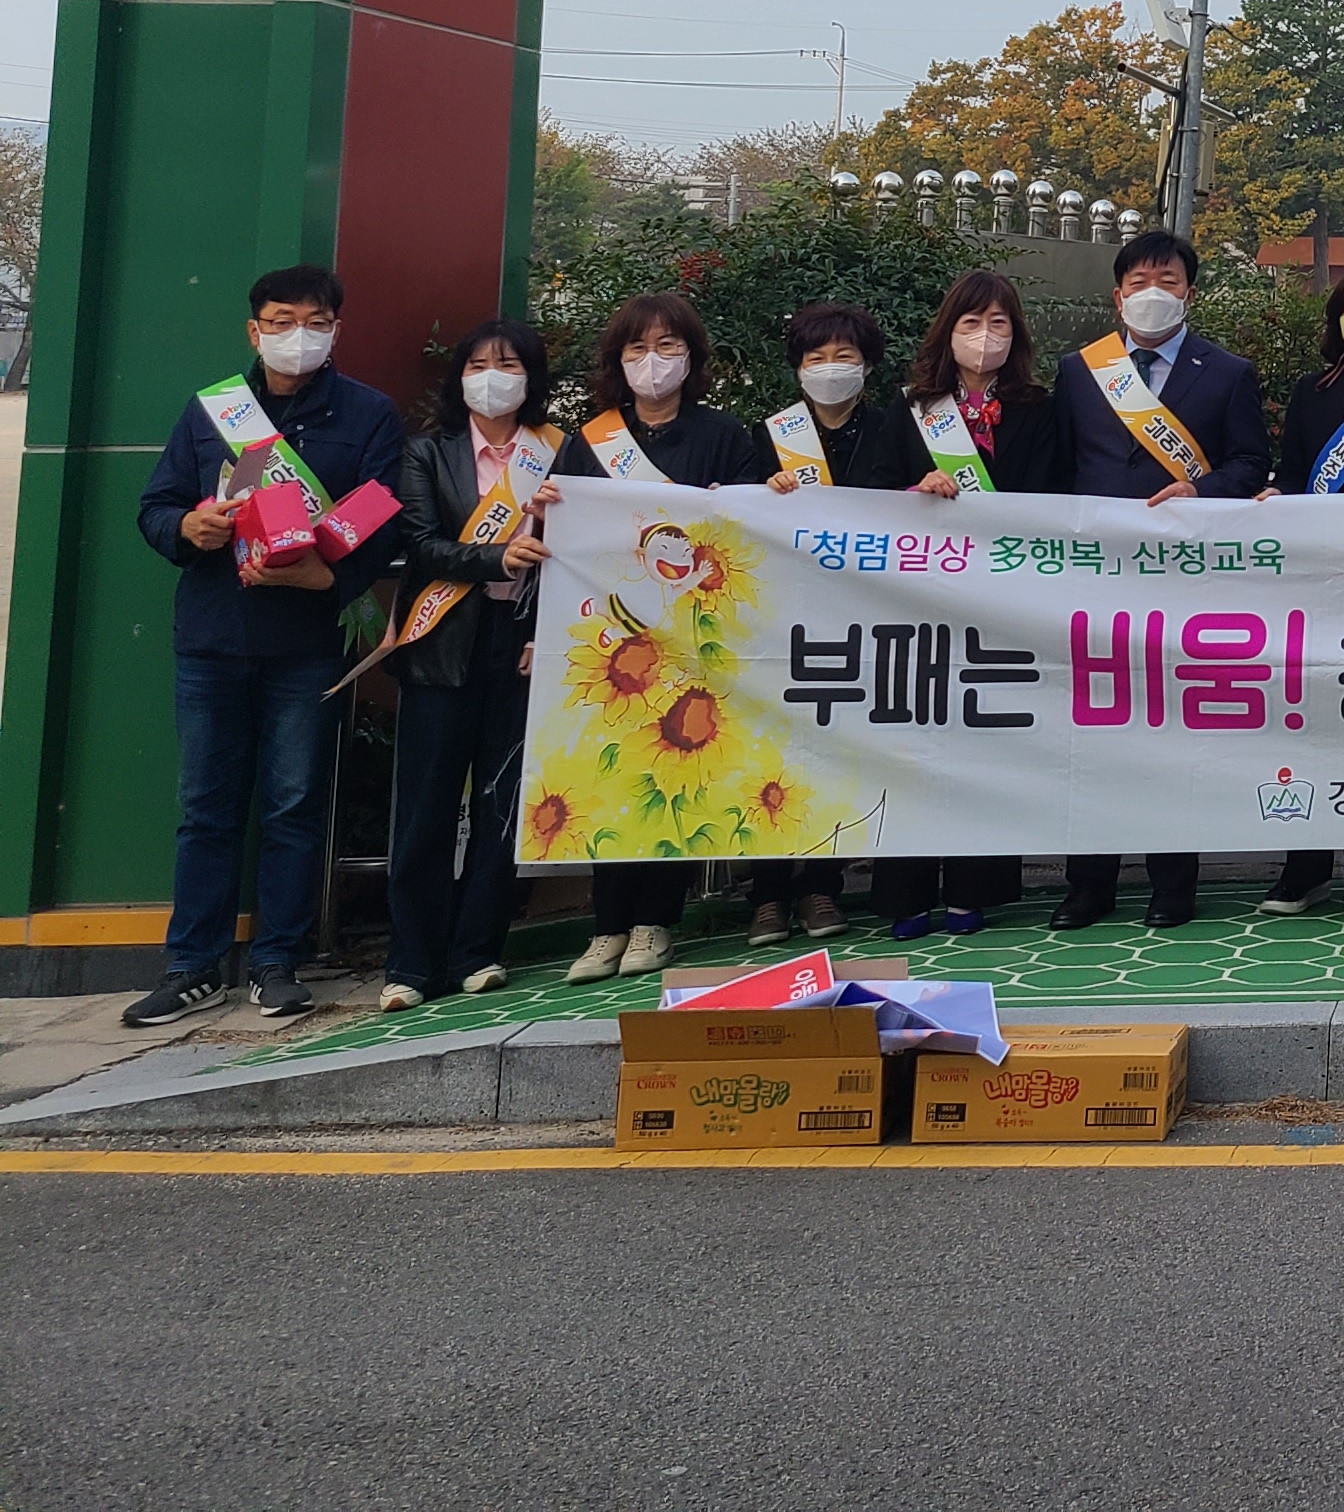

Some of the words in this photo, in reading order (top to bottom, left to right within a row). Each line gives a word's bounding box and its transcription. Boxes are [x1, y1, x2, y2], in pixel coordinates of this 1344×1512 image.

[1131, 538, 1286, 576] 산청교육
[783, 622, 1040, 727] 부패는
[1071, 609, 1305, 730] 비움!
